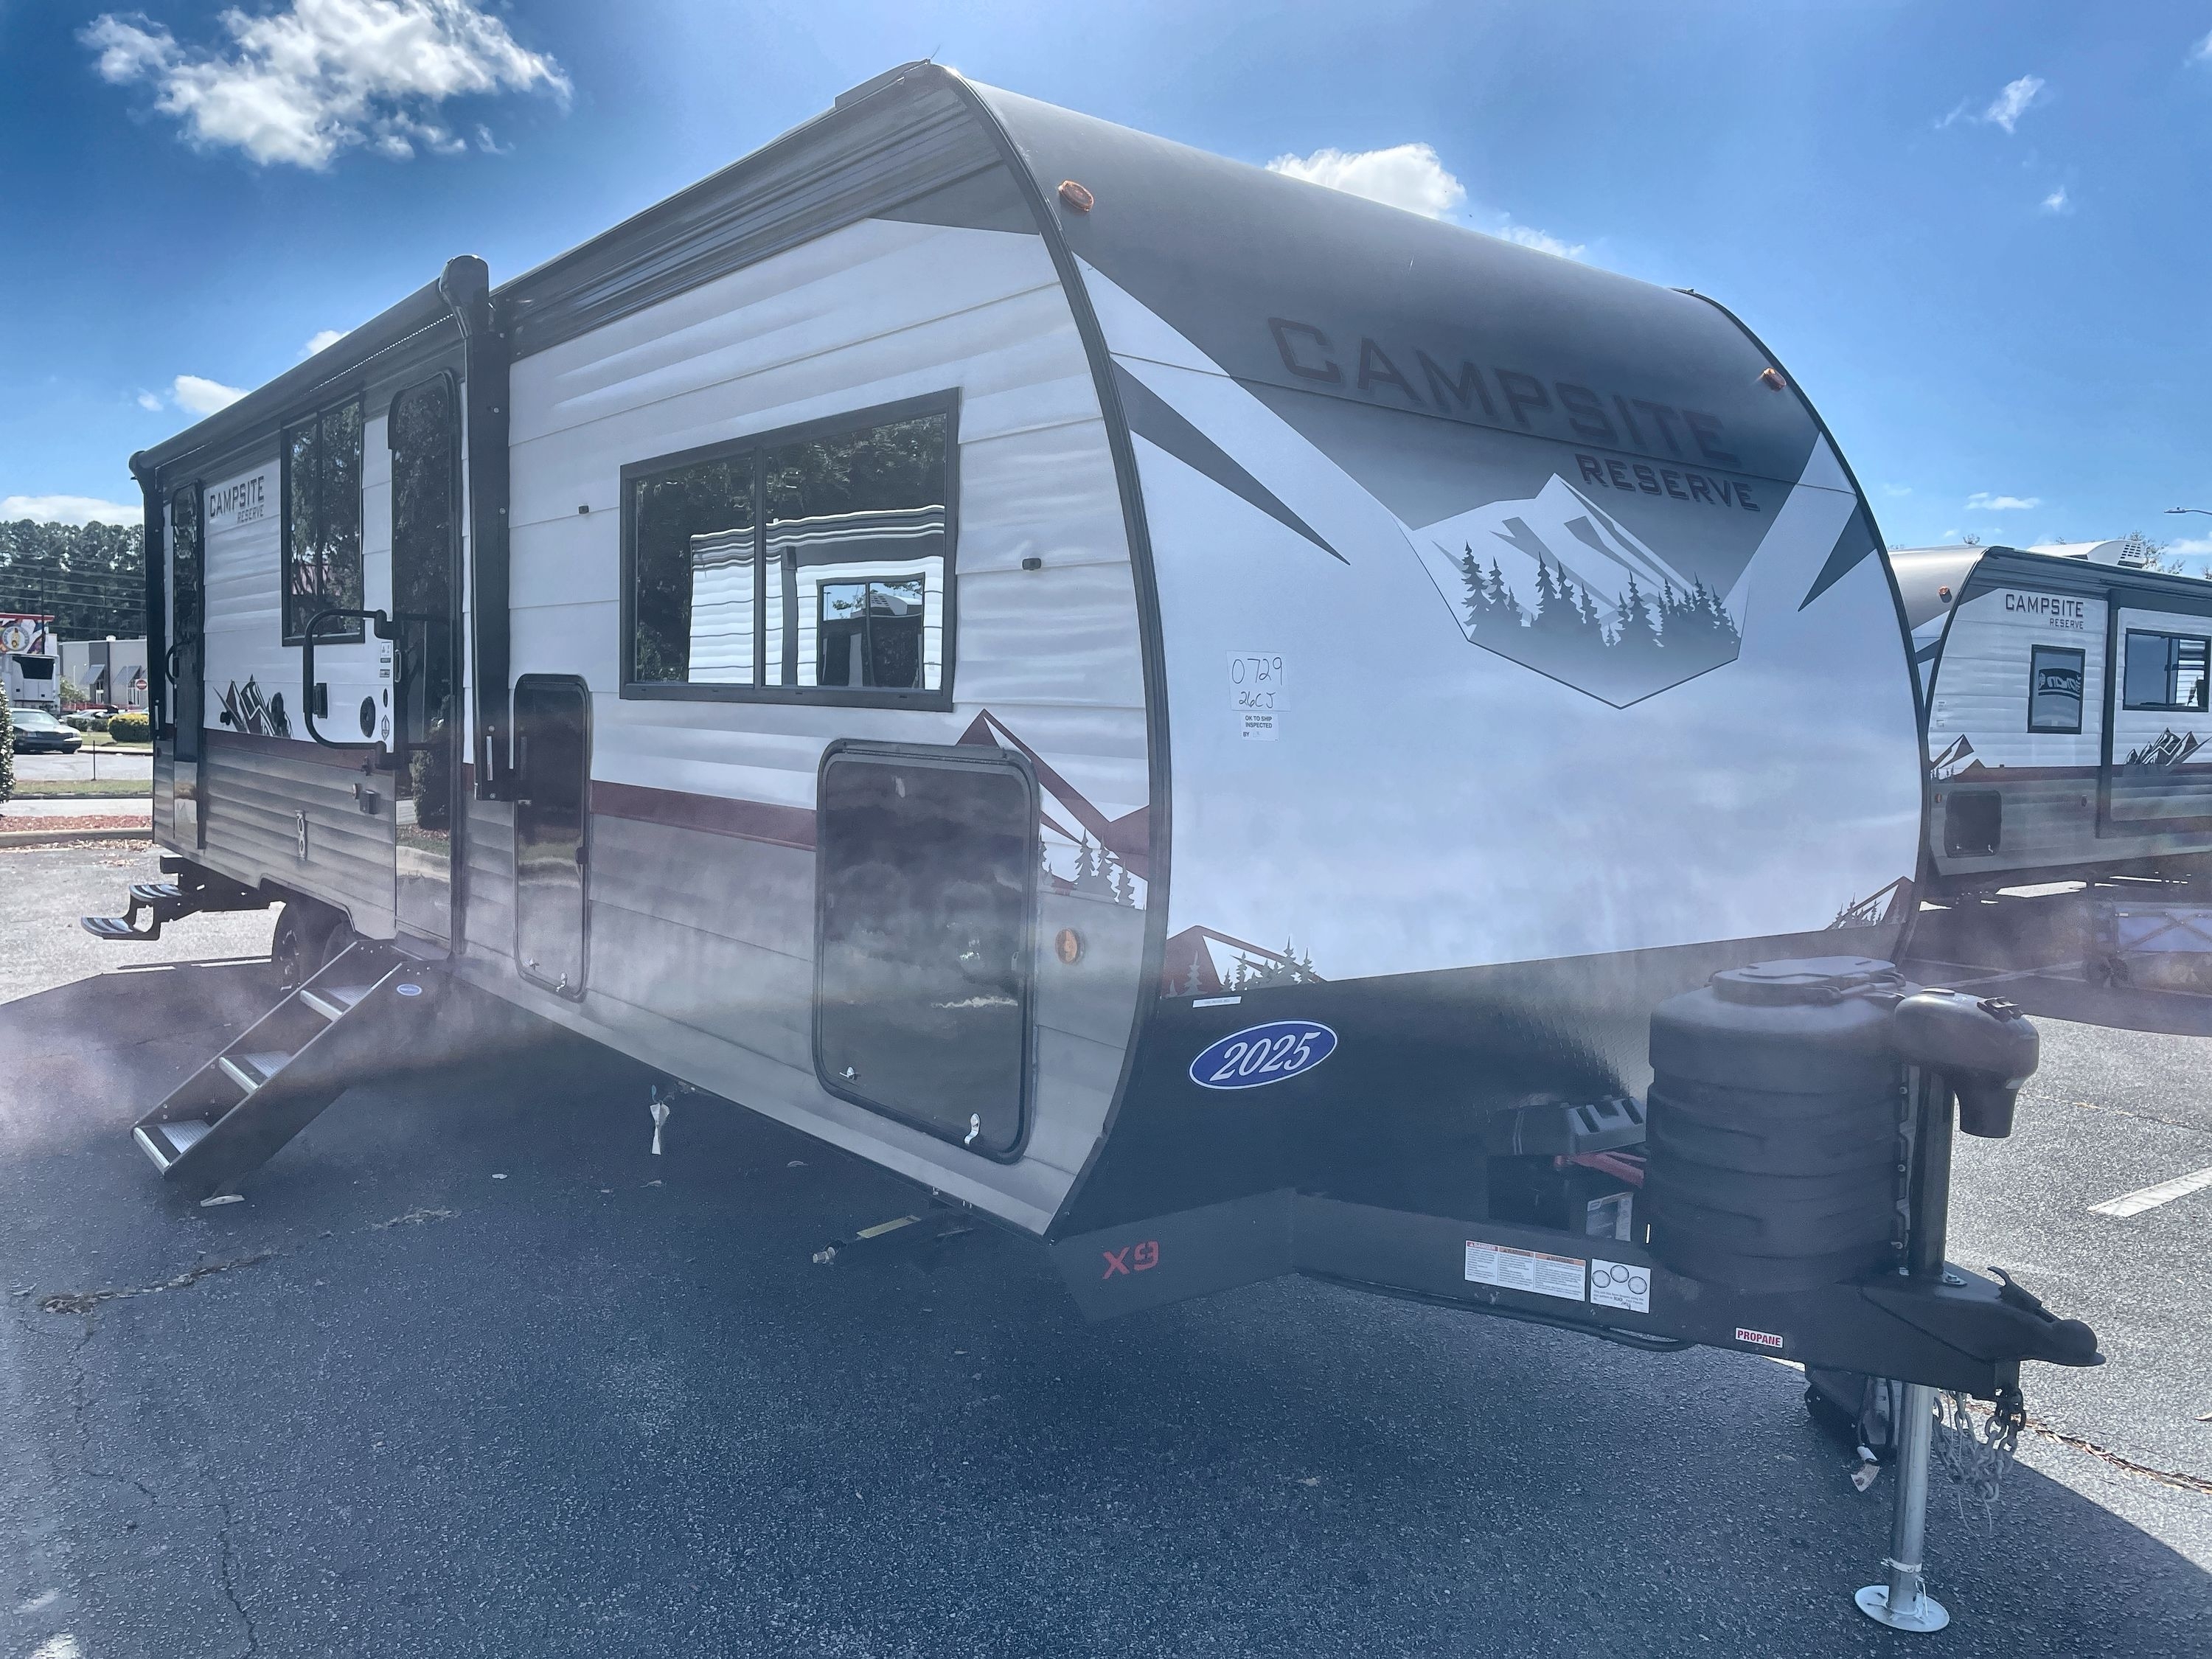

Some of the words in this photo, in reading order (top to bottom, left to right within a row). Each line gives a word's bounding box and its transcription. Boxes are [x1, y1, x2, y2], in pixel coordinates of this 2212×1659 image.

[1267, 317, 1742, 467] CAMPSITE
[209, 476, 265, 518] CAMPSITE
[1575, 453, 1761, 512] RESERVE
[237, 504, 264, 524] RESERVE
[2006, 594, 2084, 618] CAMPSITE
[2050, 618, 2084, 630] RESERVE
[1231, 657, 1283, 686] 0729
[1208, 1032, 1321, 1082] 2025
[1102, 1241, 1159, 1279] X9
[1737, 1330, 1781, 1346] PROPANE
